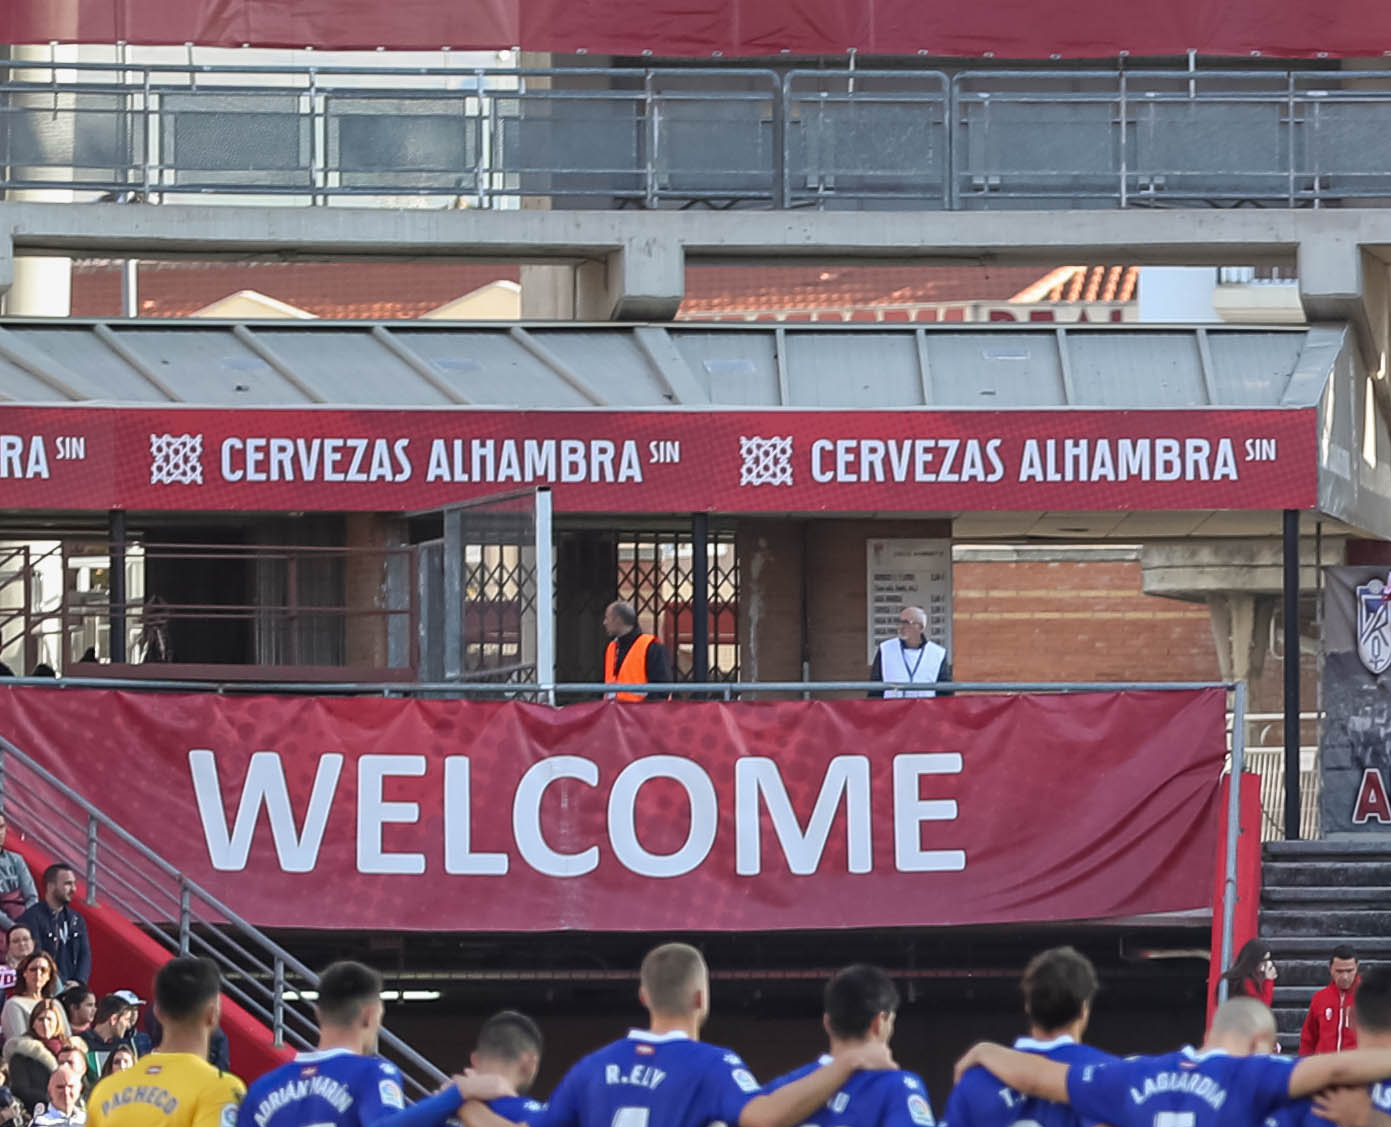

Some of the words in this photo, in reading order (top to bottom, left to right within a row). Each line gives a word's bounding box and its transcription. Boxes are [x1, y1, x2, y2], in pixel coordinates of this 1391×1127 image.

[56, 437, 86, 459] SIN
[221, 437, 412, 483] CERVEZAS
[426, 438, 643, 484] ALHAMBRA
[649, 440, 680, 465] SIN
[811, 438, 1004, 483] CERVEZAS
[1019, 438, 1239, 482] ALHAMBRA
[1245, 438, 1277, 462] SIN
[187, 749, 967, 878] WELCOME
[102, 1085, 179, 1117] PACHECO
